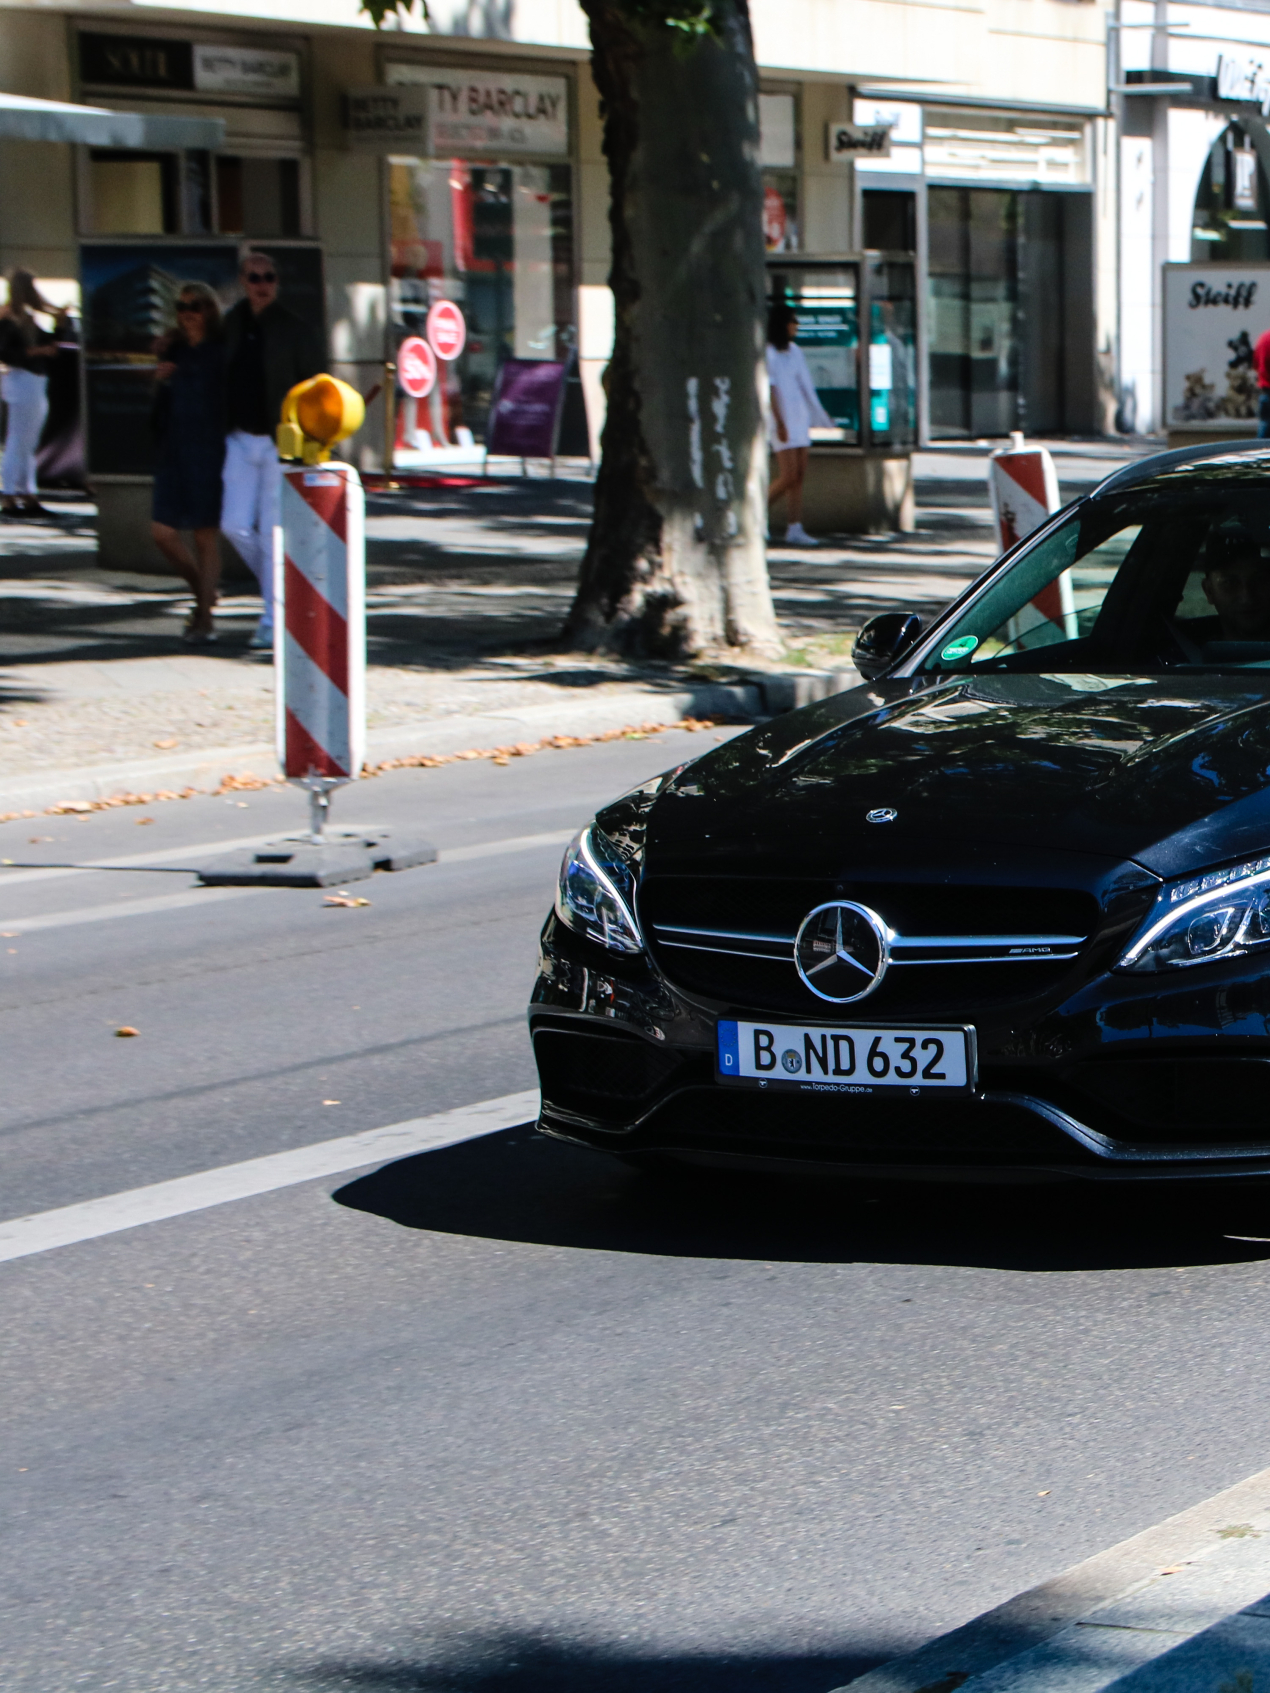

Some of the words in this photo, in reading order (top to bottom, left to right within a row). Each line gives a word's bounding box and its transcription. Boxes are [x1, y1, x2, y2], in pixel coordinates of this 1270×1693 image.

[467, 85, 560, 121] BARCLAY
[1188, 279, 1258, 311] Steiff
[725, 1054, 733, 1066] D
[753, 1028, 777, 1071] B
[803, 1032, 856, 1076] ND
[866, 1036, 946, 1080] 632
[800, 1083, 873, 1093] www.Torpedo-Gruppe.de
